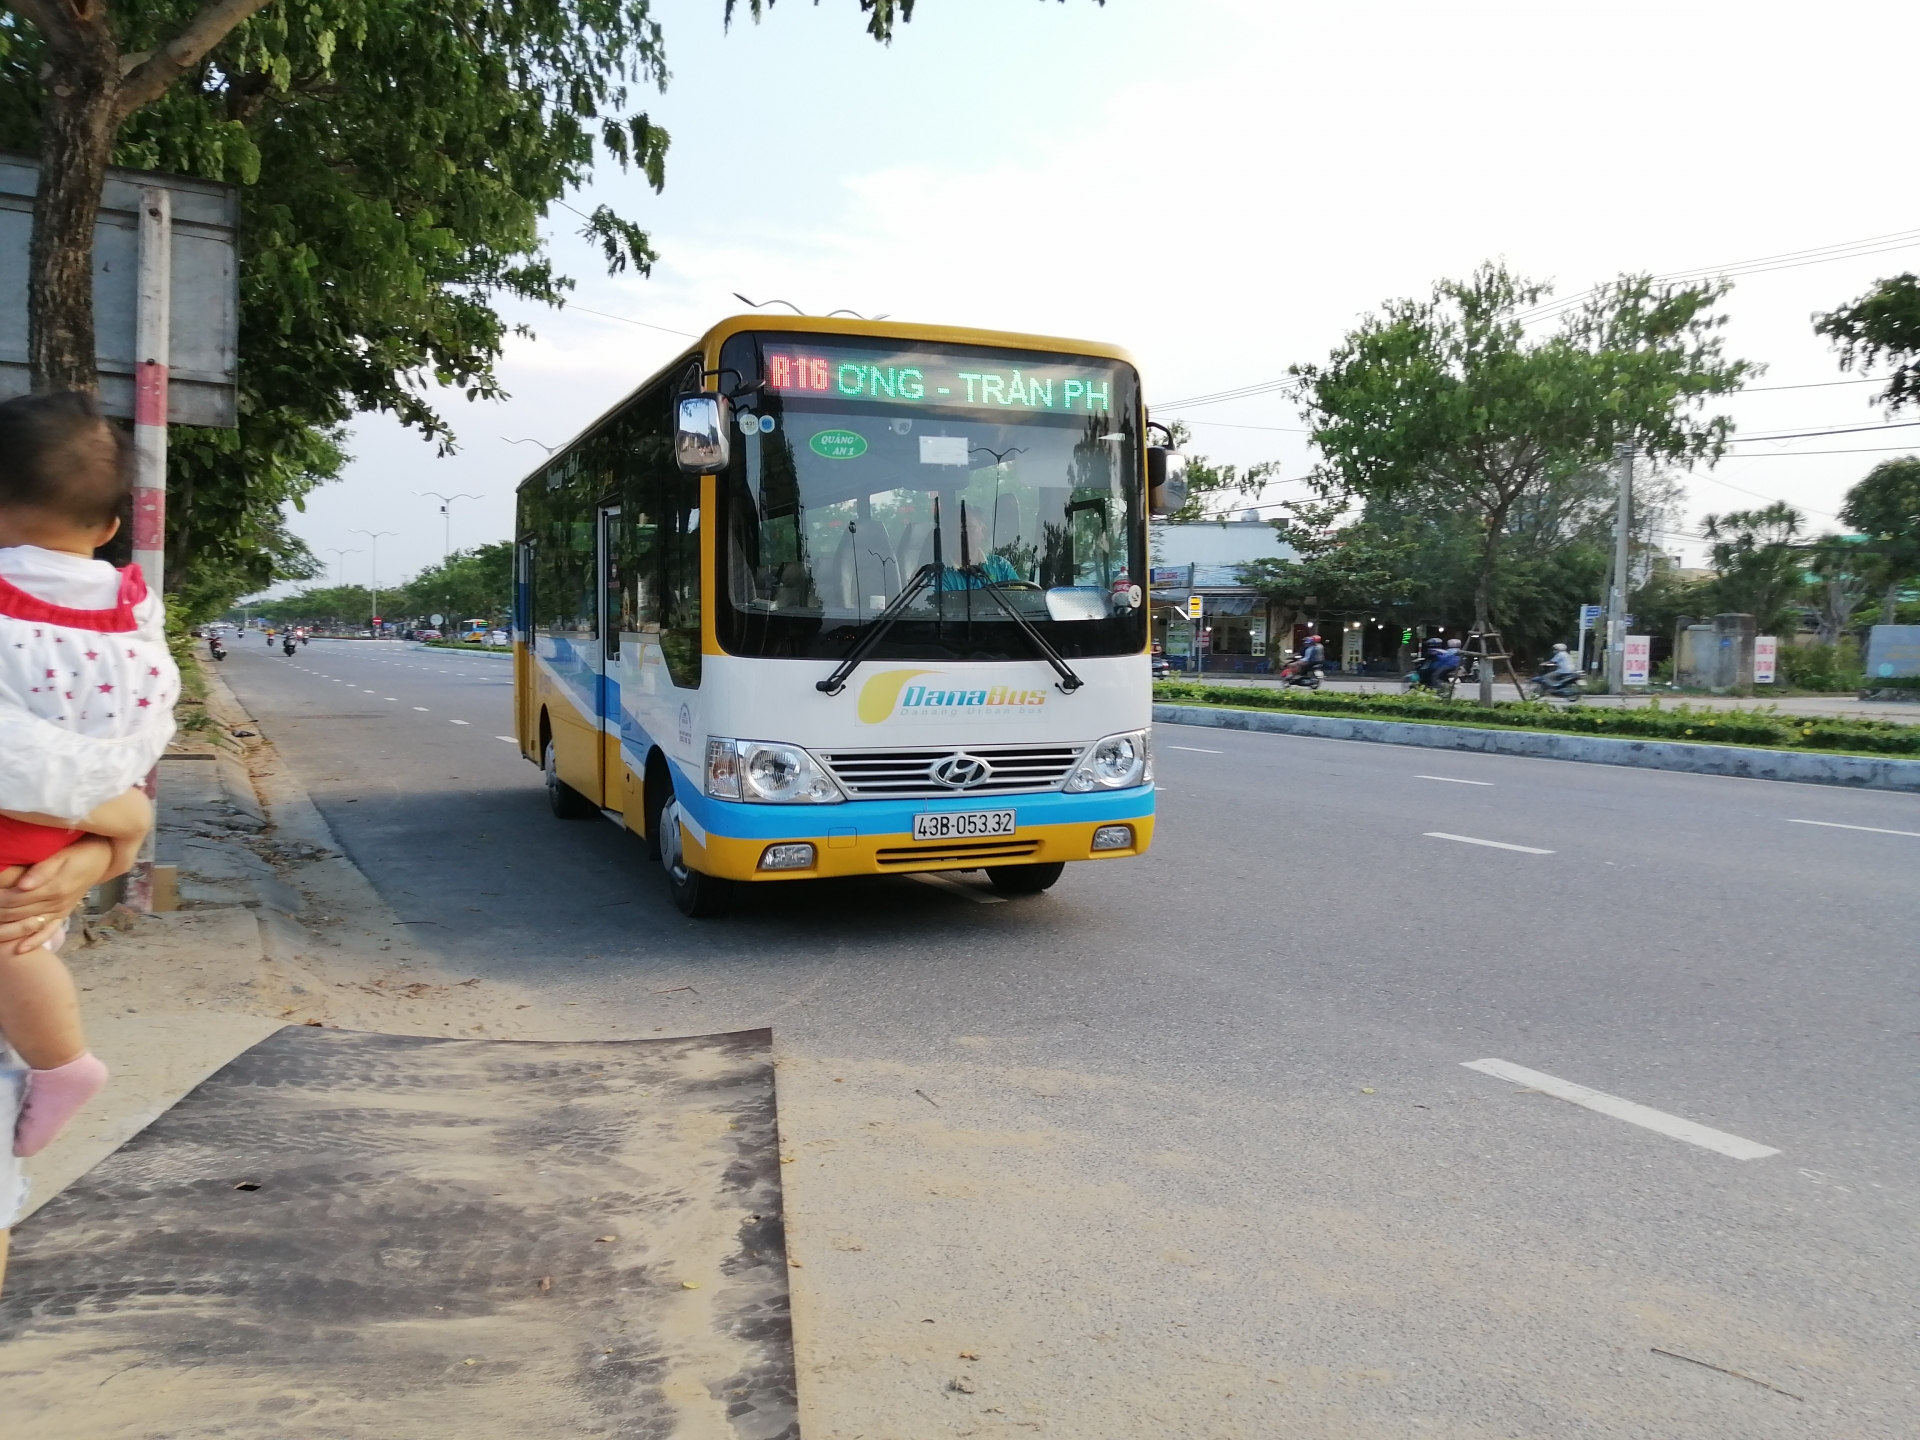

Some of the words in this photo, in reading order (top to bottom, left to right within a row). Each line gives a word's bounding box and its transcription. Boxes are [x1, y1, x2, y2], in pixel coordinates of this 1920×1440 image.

[771, 355, 828, 390] R16
[1063, 379, 1109, 410] PH
[902, 686, 1047, 707] DanaBus
[900, 708, 957, 717] Danang
[967, 706, 1010, 715] Urban
[1018, 706, 1042, 714] bus
[918, 812, 1012, 837] 43B-053.32
